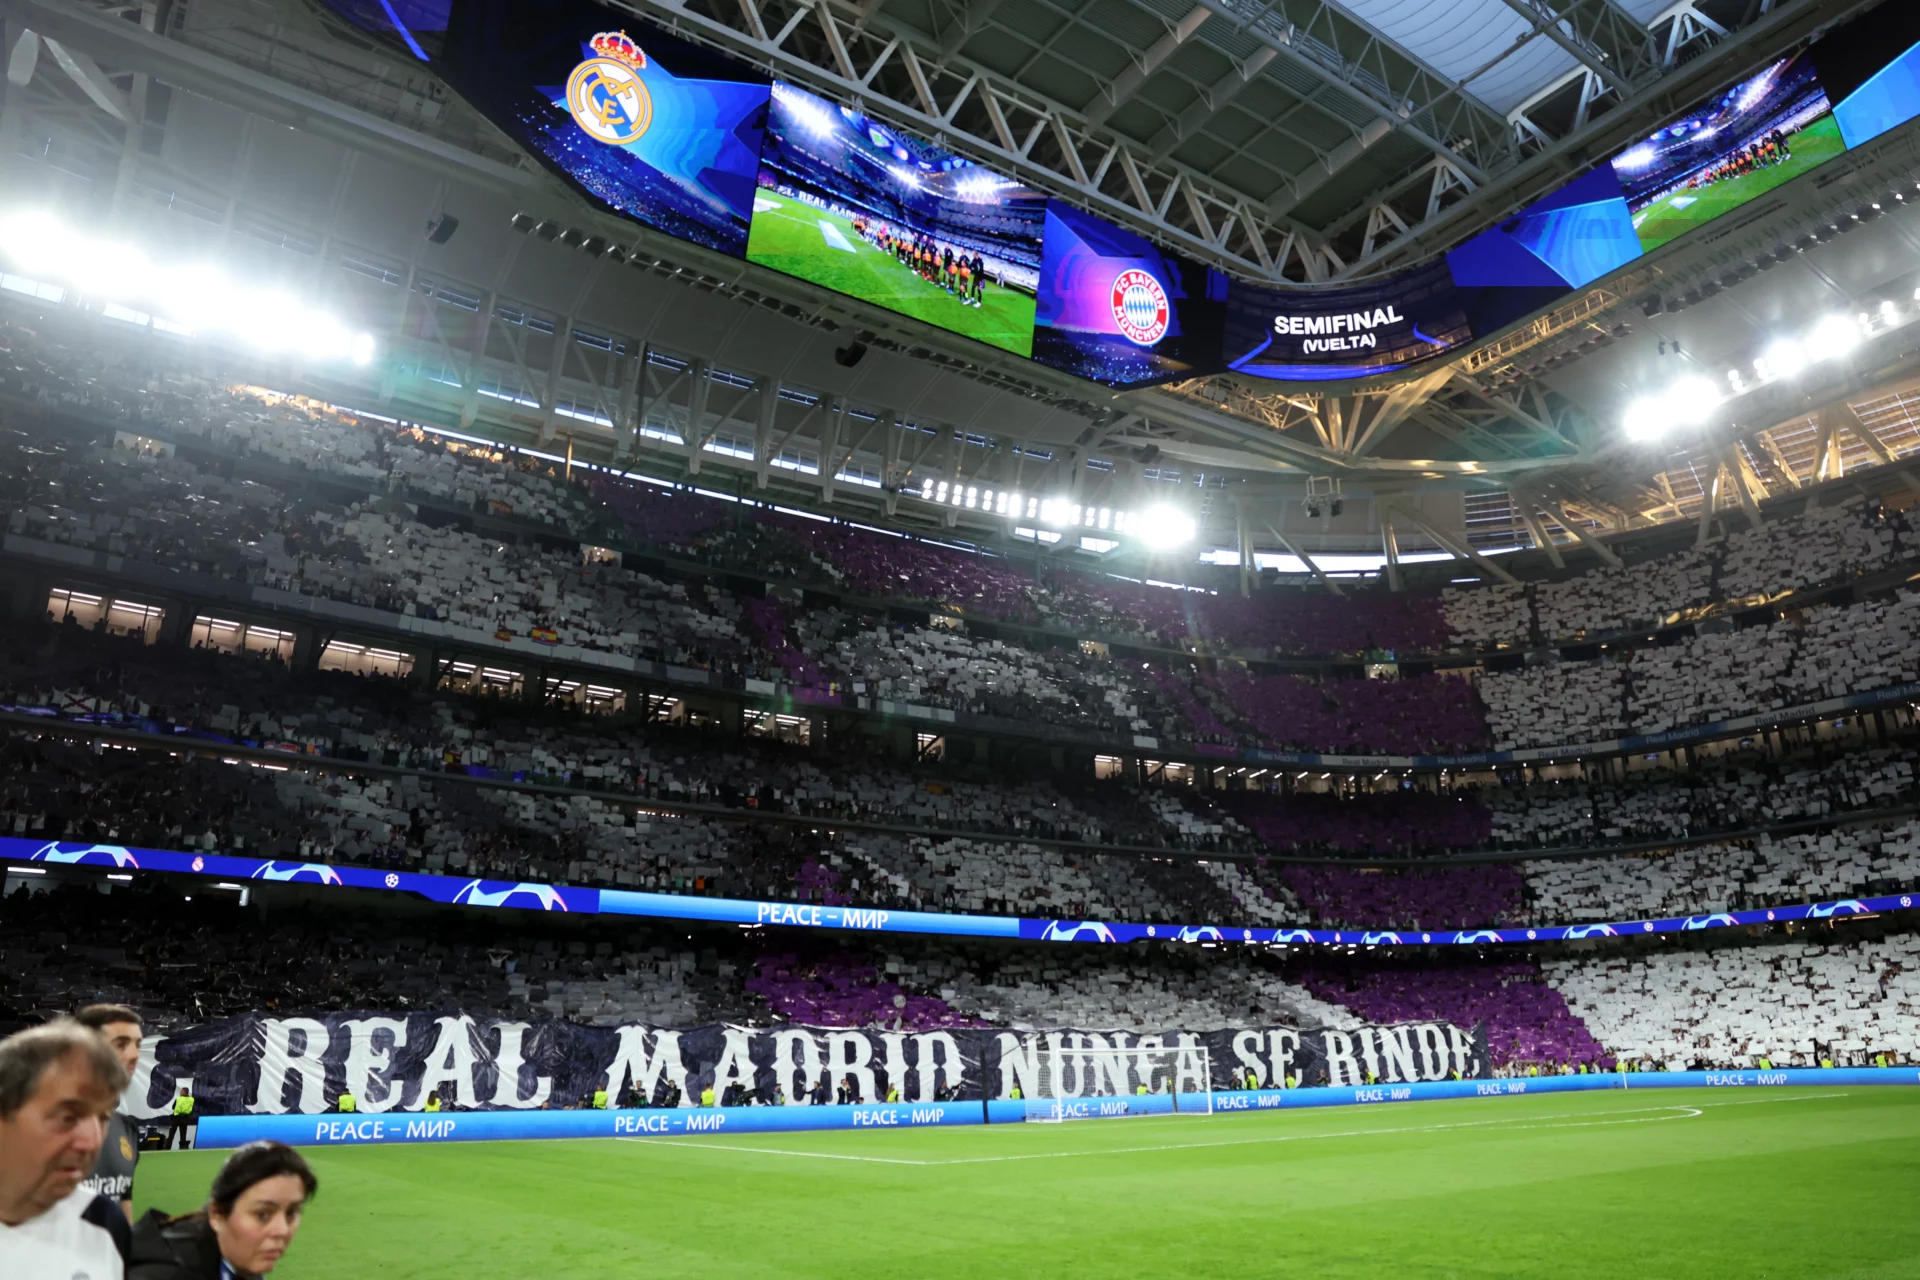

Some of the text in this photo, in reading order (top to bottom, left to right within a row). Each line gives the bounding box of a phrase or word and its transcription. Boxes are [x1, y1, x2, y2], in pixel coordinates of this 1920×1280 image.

[1116, 273, 1165, 309] FC BAYERN
[1274, 305, 1404, 335] SEMIFINAL
[1302, 333, 1377, 355] (VUELTA)
[1877, 688, 1901, 700] Real
[1755, 707, 1815, 726] Real Madrid
[1646, 729, 1699, 745] Real Madrid
[1257, 752, 1299, 763] Real Madrid
[1437, 754, 1487, 764] Real Madrid
[1538, 747, 1593, 759] Real Madrid
[1342, 757, 1389, 766] Real Madrid
[758, 902, 822, 926] PEACE
[842, 909, 888, 929] МИР
[246, 1016, 552, 1114] REAL
[604, 1025, 966, 1108] MADRID
[995, 1032, 1206, 1100] NUNCA
[1232, 1029, 1303, 1090] SE
[1320, 1023, 1480, 1088] RINDE
[1706, 1075, 1745, 1086] PEACE
[1757, 1074, 1788, 1085] МИР
[1355, 1090, 1384, 1102] PEACE
[1391, 1088, 1412, 1099] МИР
[1477, 1083, 1501, 1095] PEACE
[1508, 1082, 1526, 1093] МИР
[1100, 1101, 1129, 1115] МИР
[1217, 1096, 1249, 1109] PEACE
[1258, 1094, 1281, 1107] МИР
[615, 1114, 669, 1133] PEACE
[687, 1113, 726, 1131] МИР
[852, 1109, 898, 1126] PEACE
[912, 1107, 944, 1124] МИР
[316, 1121, 385, 1141] PEACE
[407, 1119, 456, 1138] МИР
